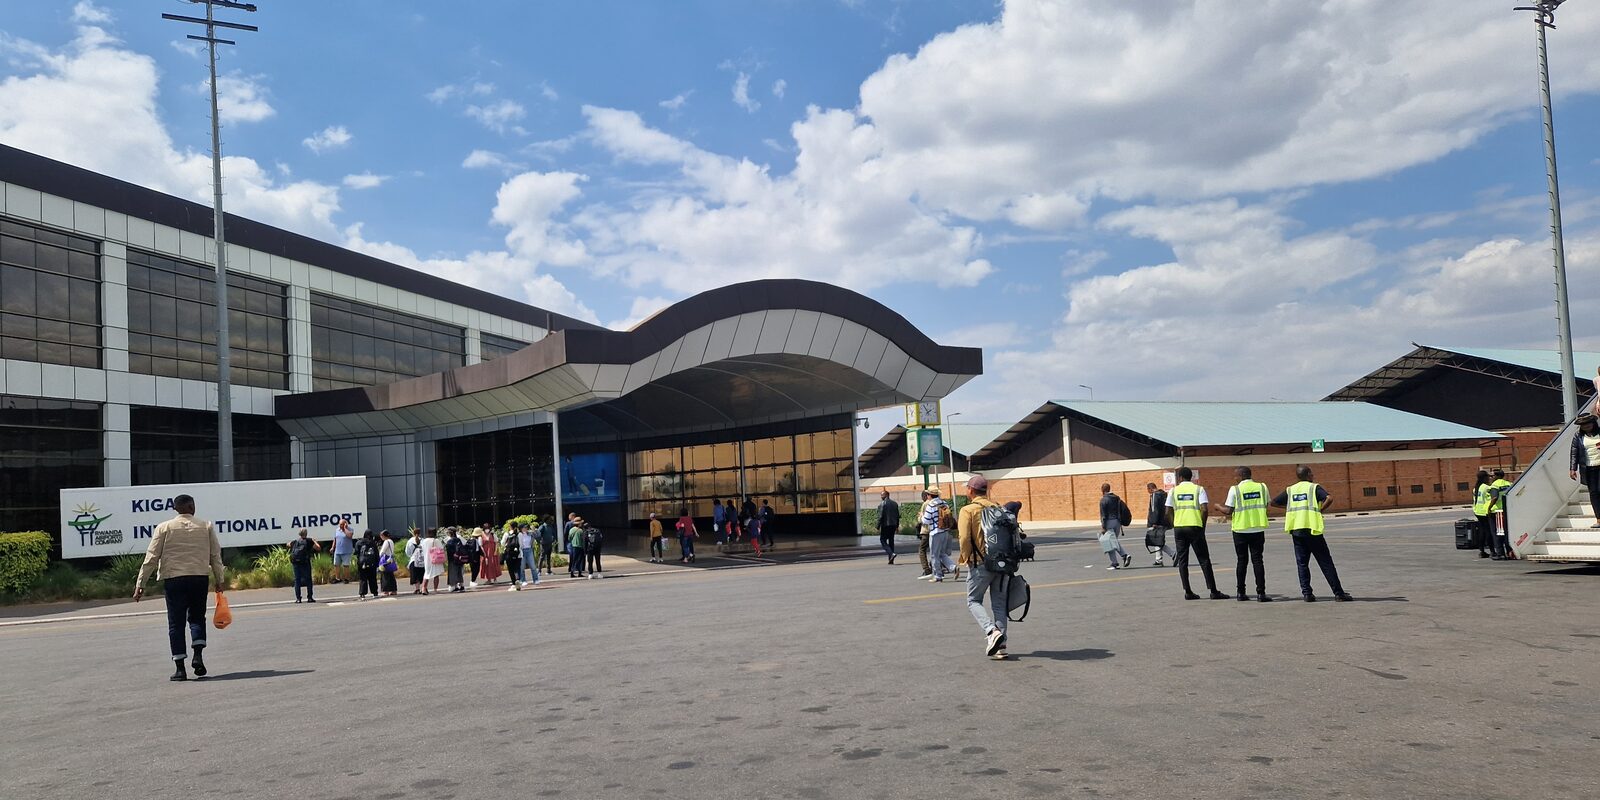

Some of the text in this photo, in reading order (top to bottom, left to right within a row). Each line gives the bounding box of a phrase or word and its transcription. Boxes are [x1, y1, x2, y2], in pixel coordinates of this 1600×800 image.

[131, 498, 176, 513] KIGA
[133, 512, 362, 539] INTIONAL AIRPORT
